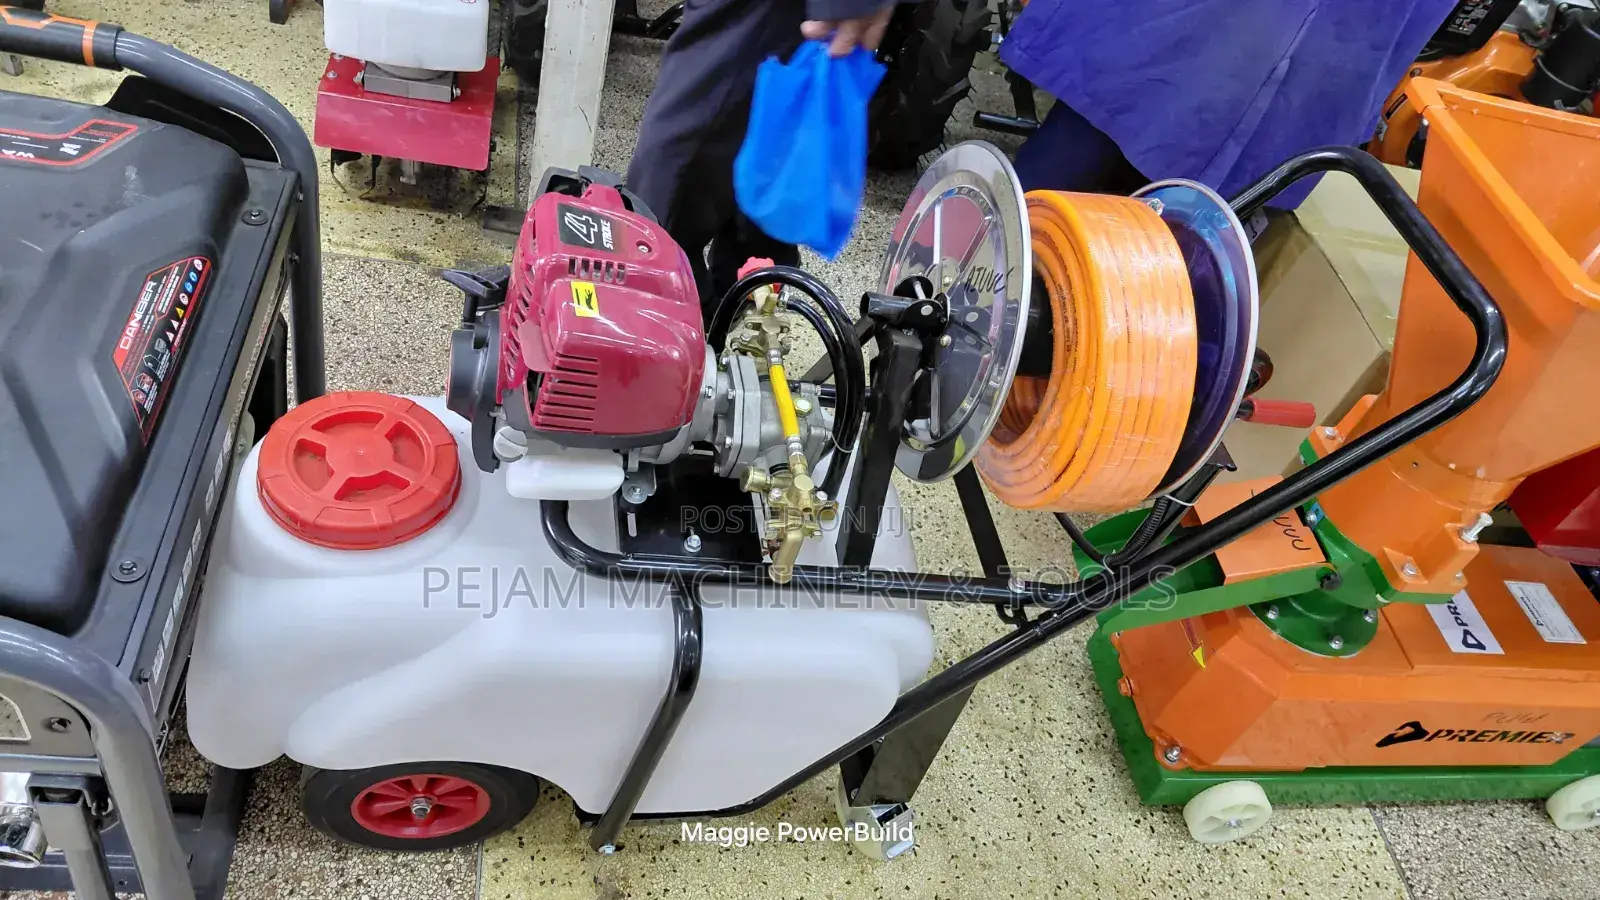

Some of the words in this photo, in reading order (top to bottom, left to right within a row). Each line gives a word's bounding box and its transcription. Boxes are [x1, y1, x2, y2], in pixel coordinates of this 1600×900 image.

[564, 212, 598, 244] 4
[600, 219, 614, 250] STROKE
[119, 280, 158, 350] DANGER
[1424, 728, 1575, 745] PREMIER
